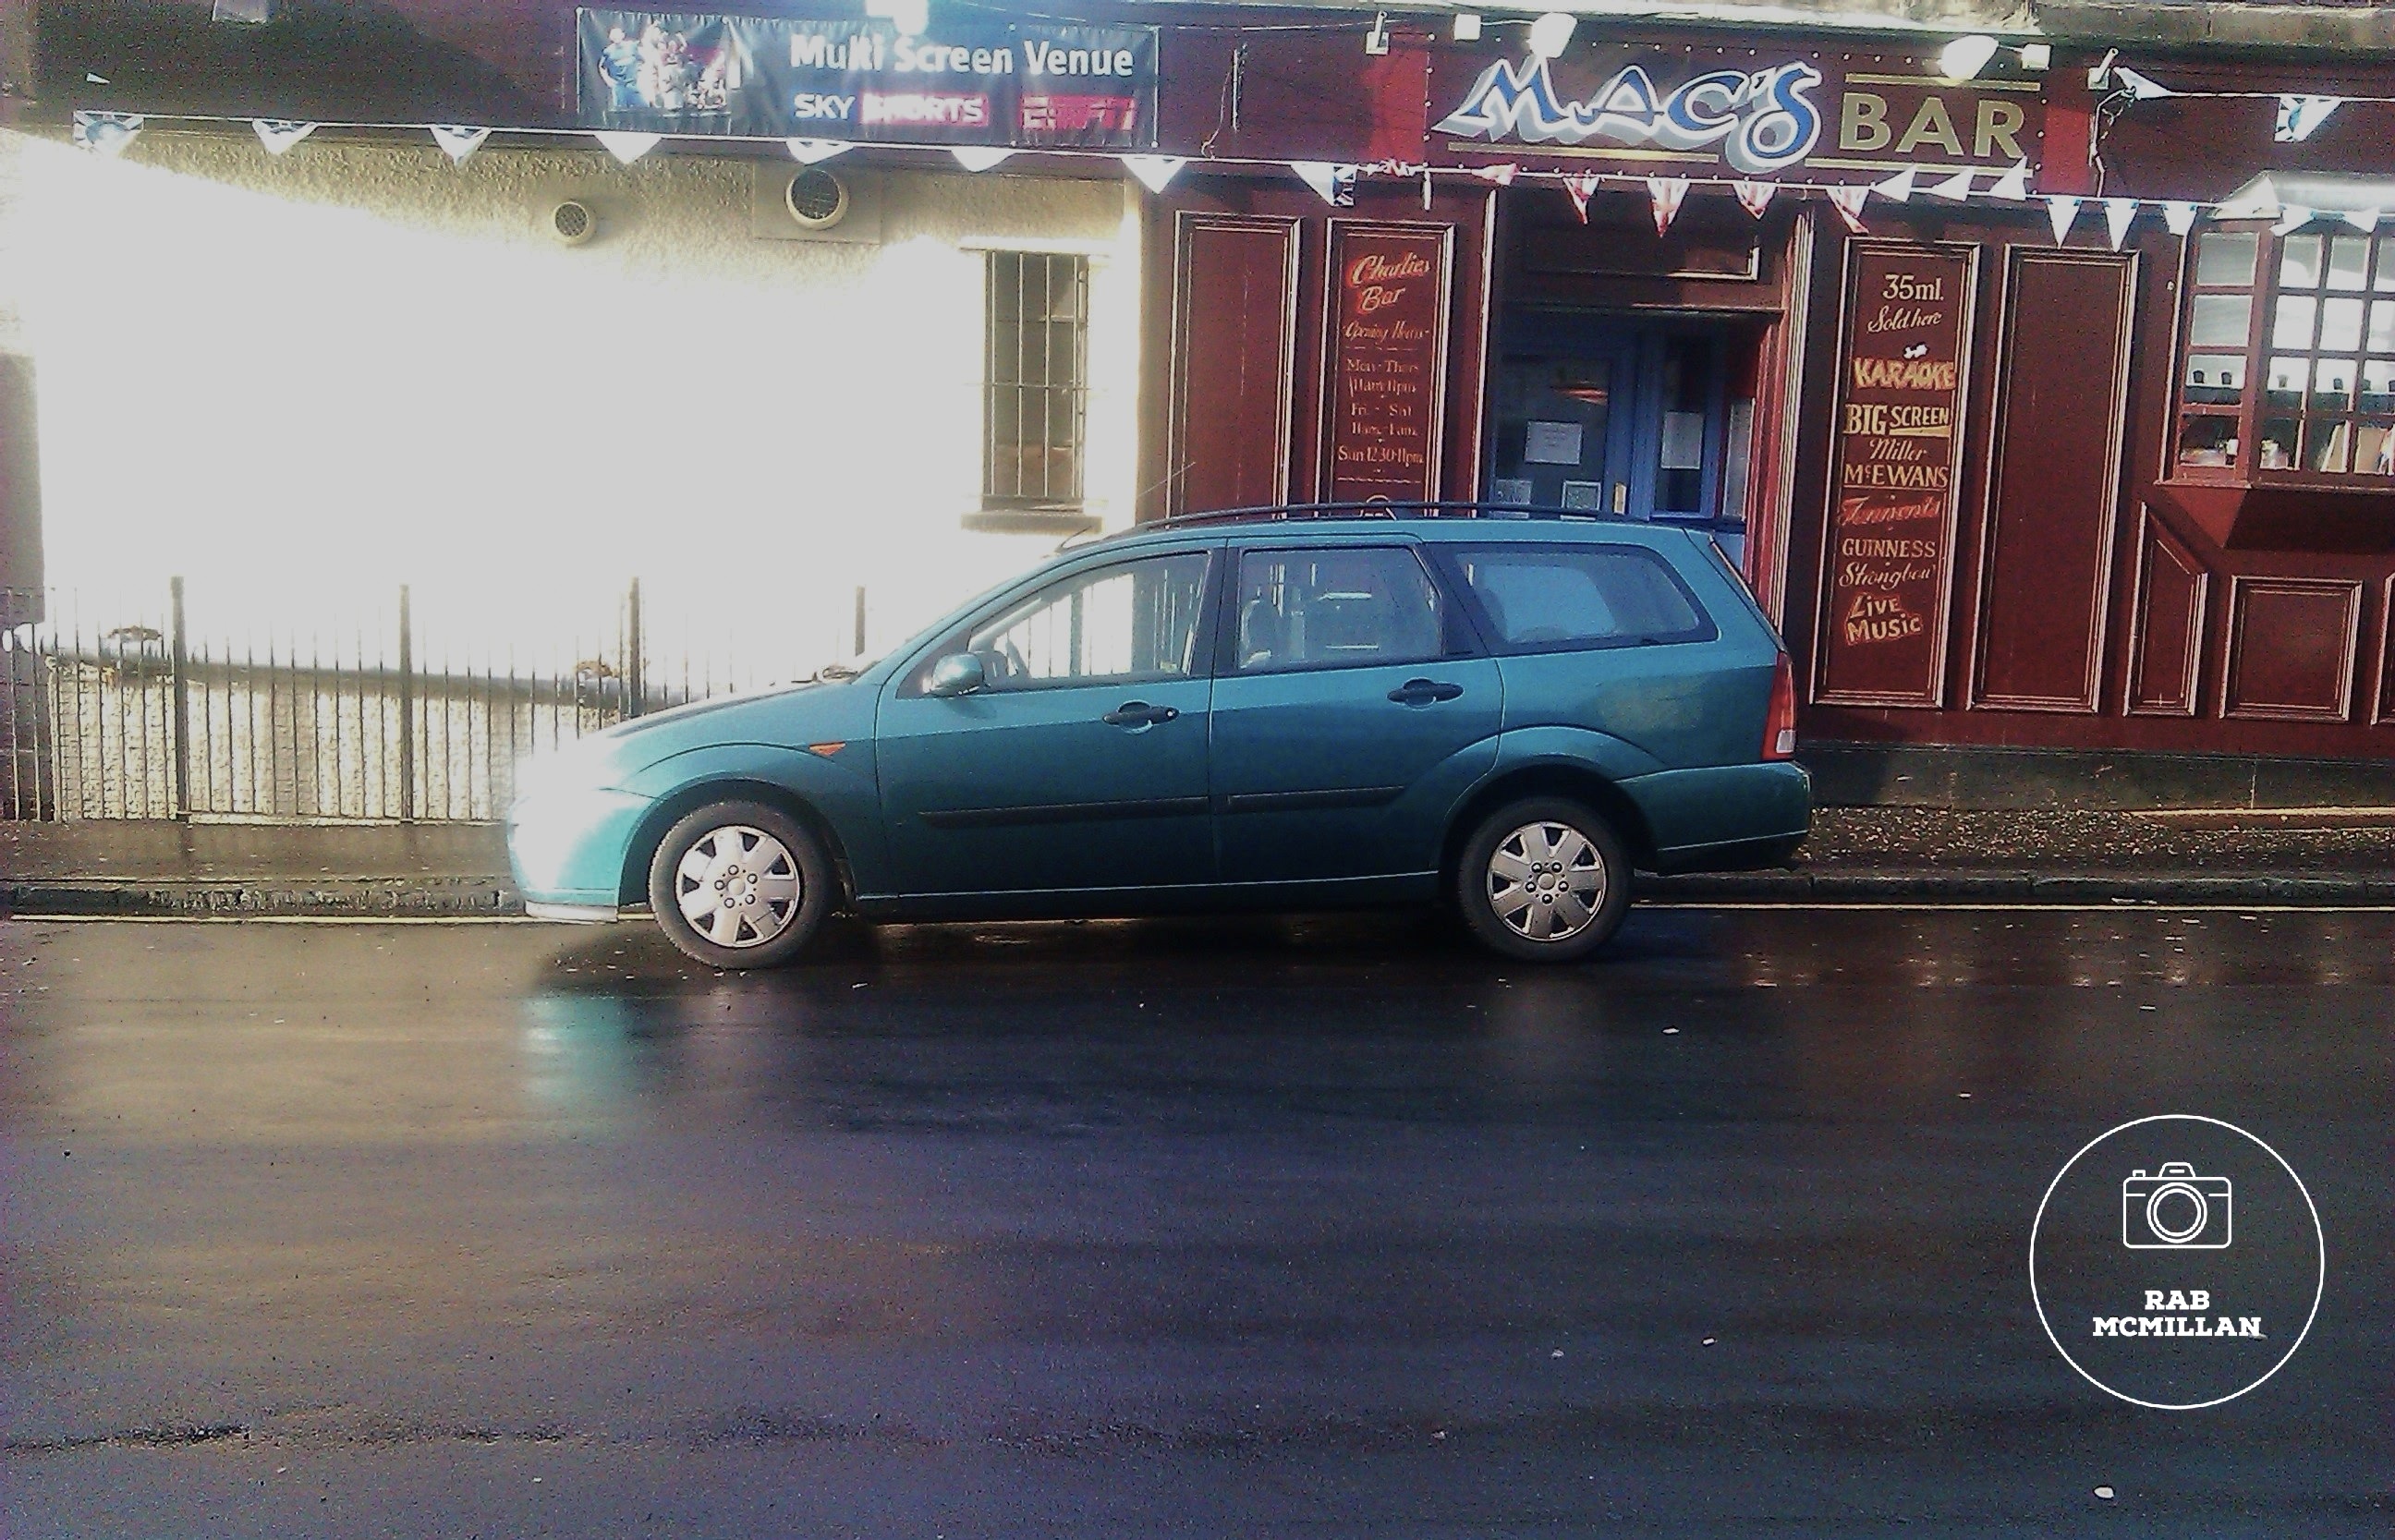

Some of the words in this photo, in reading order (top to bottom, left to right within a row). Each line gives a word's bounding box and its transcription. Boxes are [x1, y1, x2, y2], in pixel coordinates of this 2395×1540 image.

[790, 33, 883, 71] Multi
[894, 35, 1014, 75] Screen
[1024, 39, 1135, 78] Venue
[794, 93, 856, 119] SKY
[1839, 91, 2027, 159] BAR
[1356, 285, 1405, 314] Bar
[1867, 306, 1909, 333] Sold
[1911, 307, 1942, 328] here
[1854, 357, 1957, 391] KARAOKE
[1843, 404, 1889, 436] BIG
[1890, 406, 1950, 429] SCREEN
[1869, 436, 1927, 461] Miller
[1842, 538, 1937, 558] GUINNESS
